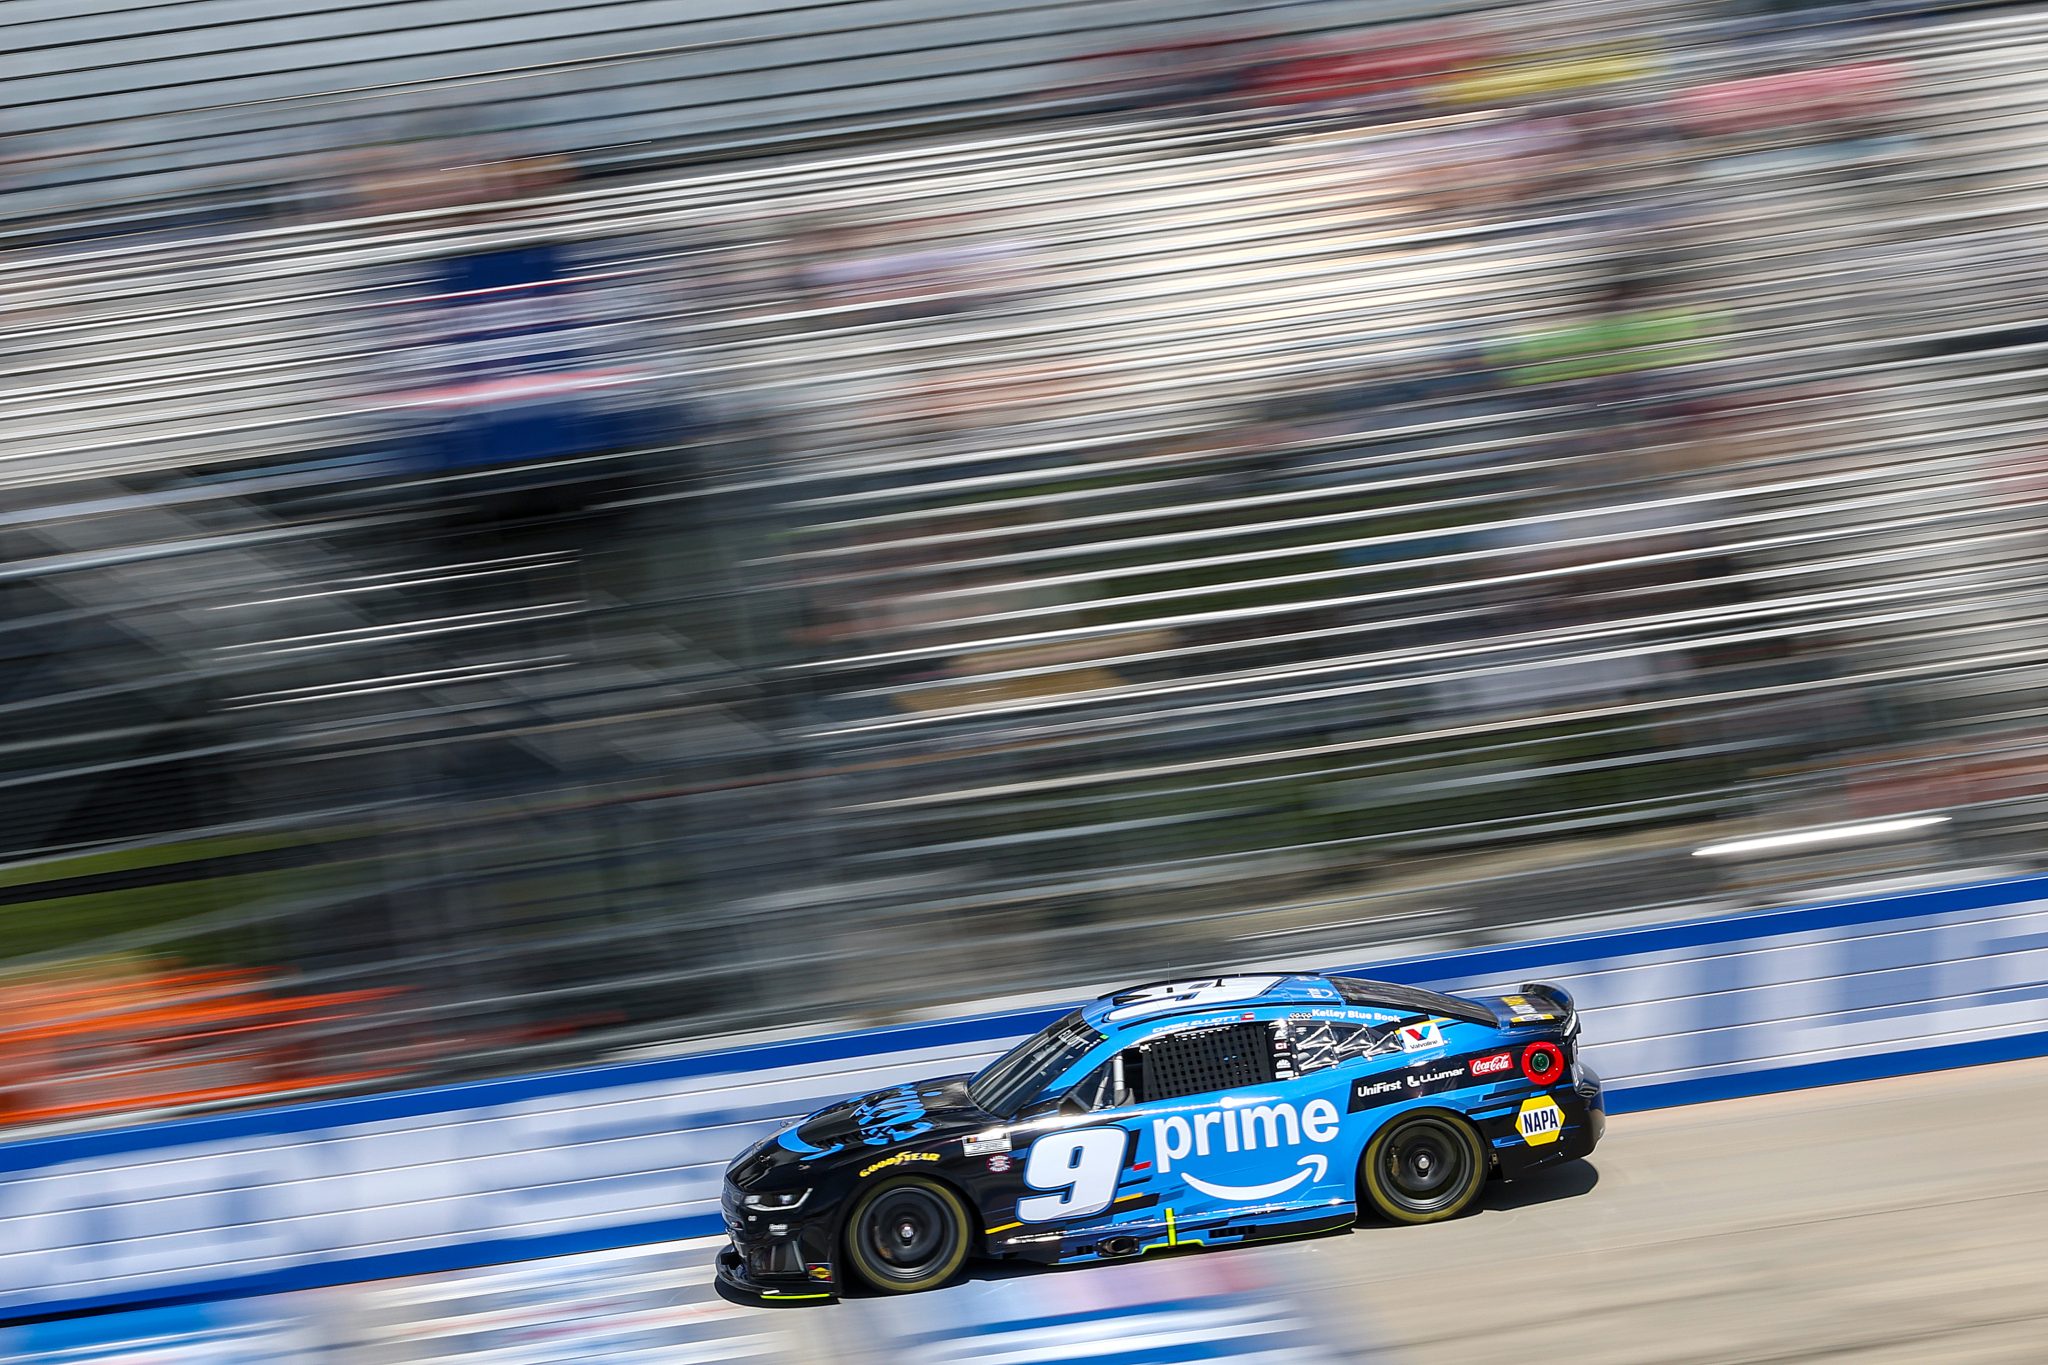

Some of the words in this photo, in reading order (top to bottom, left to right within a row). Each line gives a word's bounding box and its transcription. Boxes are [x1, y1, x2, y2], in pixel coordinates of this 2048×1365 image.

[1312, 1009, 1346, 1019] Kelley
[1347, 1010, 1373, 1019] Blue
[1374, 1012, 1401, 1022] Book
[1410, 1039, 1438, 1050] Valvoline
[1357, 1080, 1402, 1097] UniFirst
[1523, 1108, 1559, 1133] NAPA
[1153, 1098, 1340, 1173] prime
[859, 1151, 941, 1177] GOODYEAR
[1017, 1125, 1128, 1223] 9
